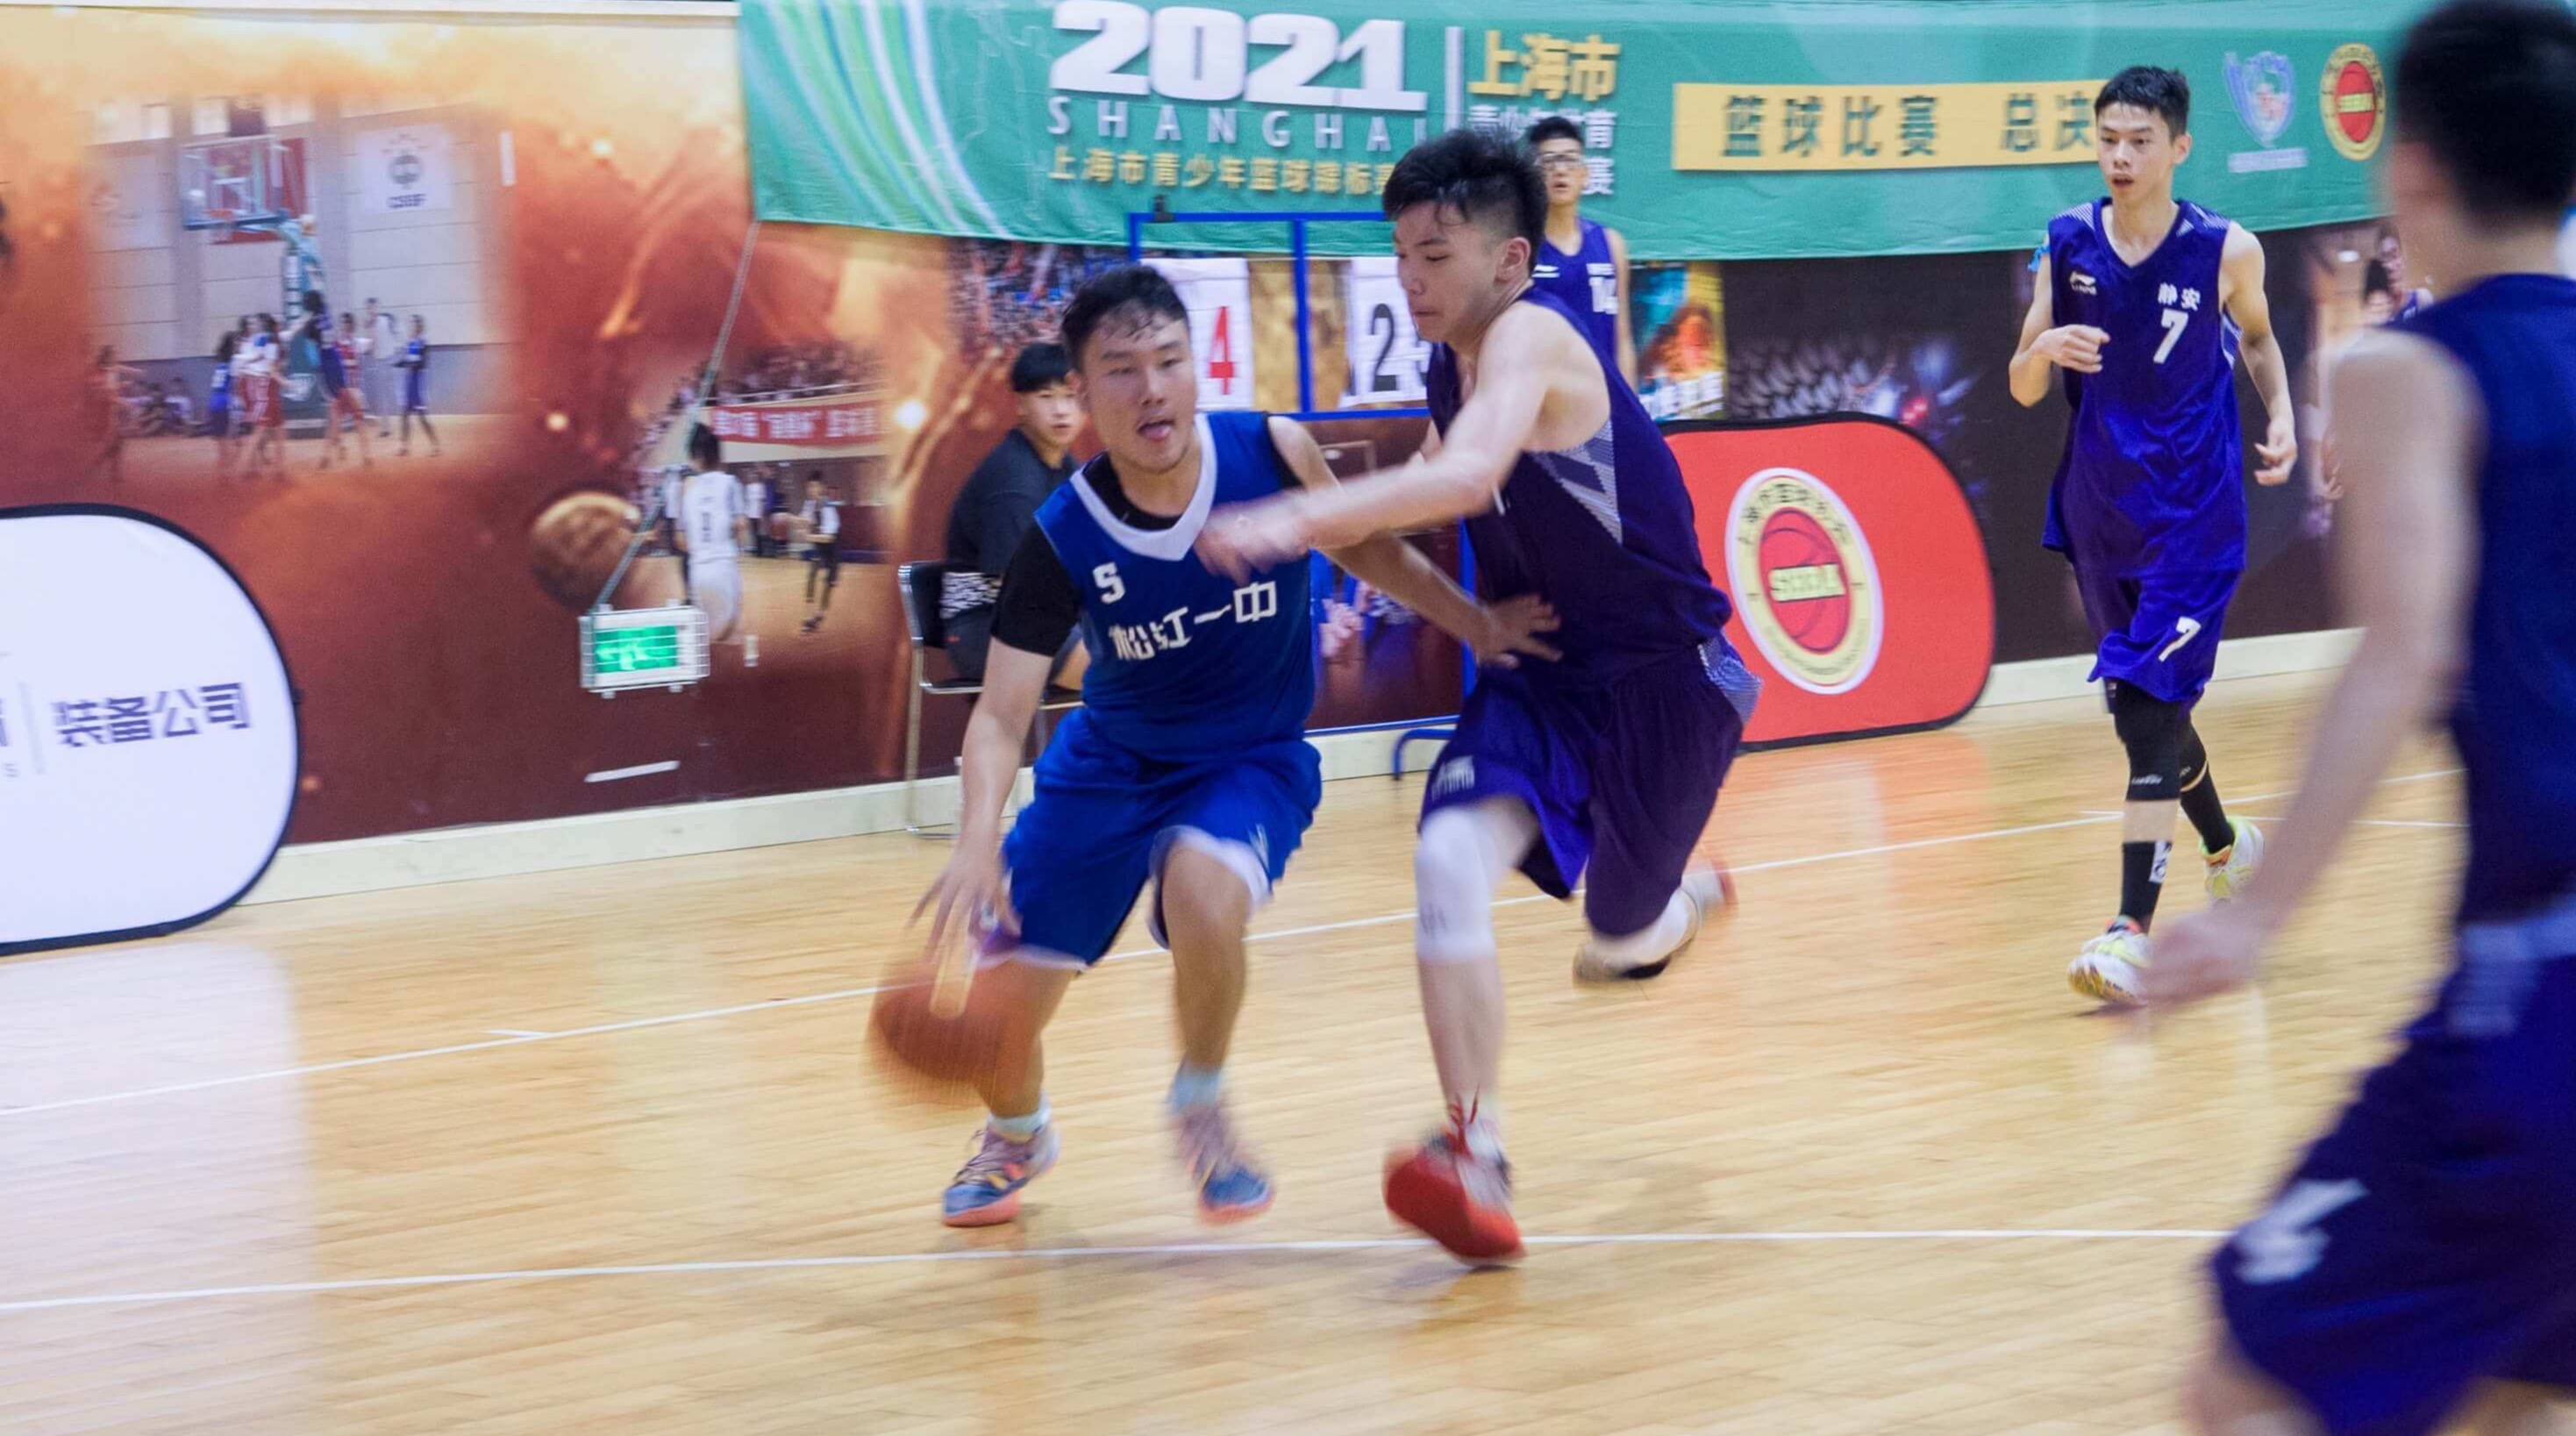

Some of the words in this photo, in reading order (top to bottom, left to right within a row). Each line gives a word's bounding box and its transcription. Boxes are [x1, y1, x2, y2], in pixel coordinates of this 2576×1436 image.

[1050, 0, 1428, 111] 2021
[1467, 30, 1620, 101] 上海市
[1046, 95, 1428, 152] SHANGHAI
[1722, 95, 1938, 158] 篮球比赛
[1207, 305, 1236, 395] 4
[2153, 308, 2188, 364] 7
[1109, 580, 1277, 661] 松江一中
[2159, 616, 2201, 662] 7
[51, 682, 251, 747] 装备公司
